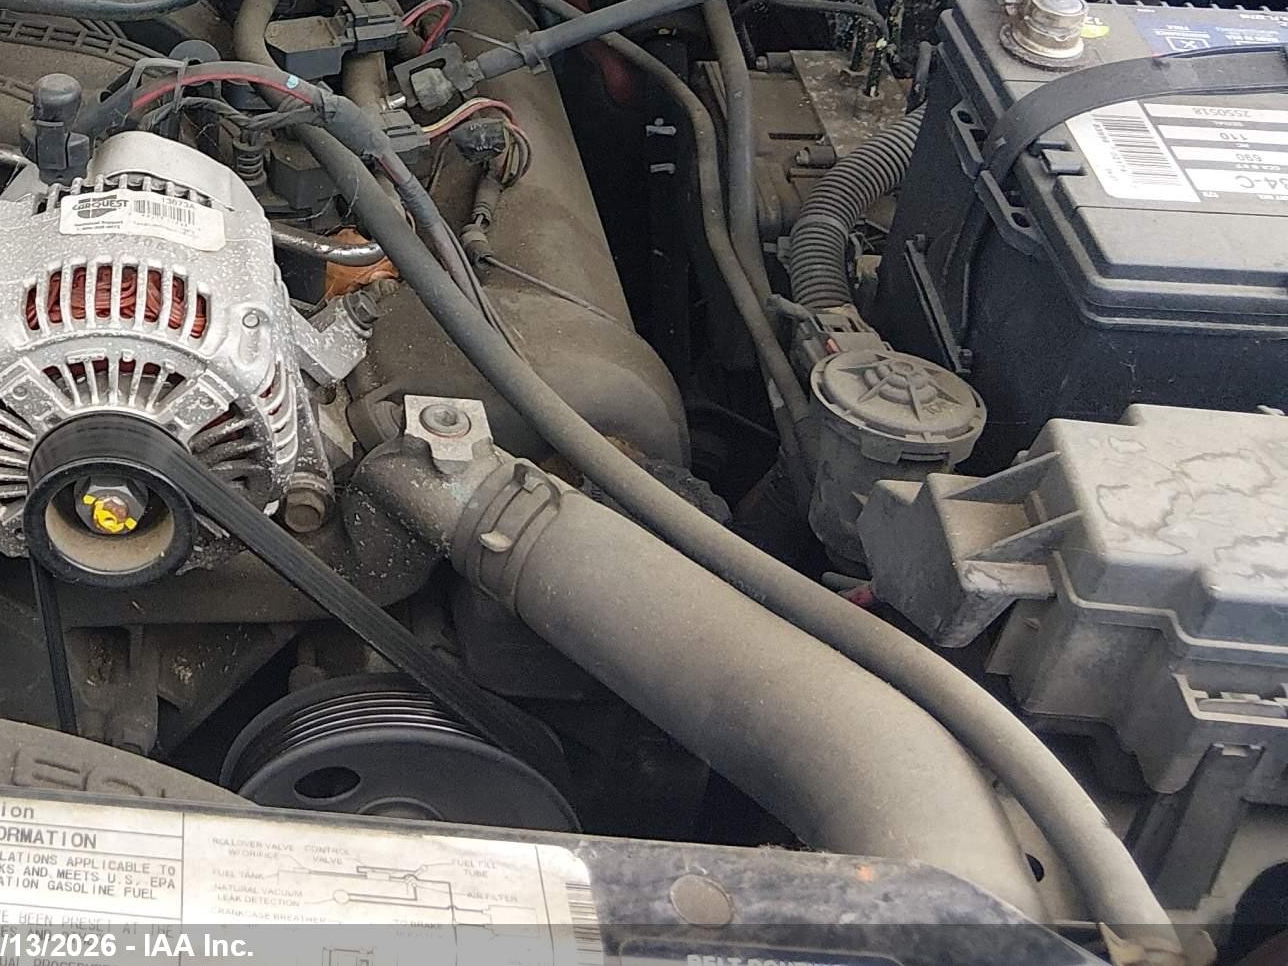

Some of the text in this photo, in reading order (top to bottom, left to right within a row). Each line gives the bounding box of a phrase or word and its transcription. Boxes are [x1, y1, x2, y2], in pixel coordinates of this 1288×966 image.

[66, 855, 150, 874] APPLICABLE
[161, 864, 175, 875] TO
[56, 868, 98, 882] MEETS
[150, 876, 175, 889] EPA
[47, 880, 114, 896] GASOLINE
[123, 886, 156, 900] FUEL
[18, 911, 52, 927] BEEN
